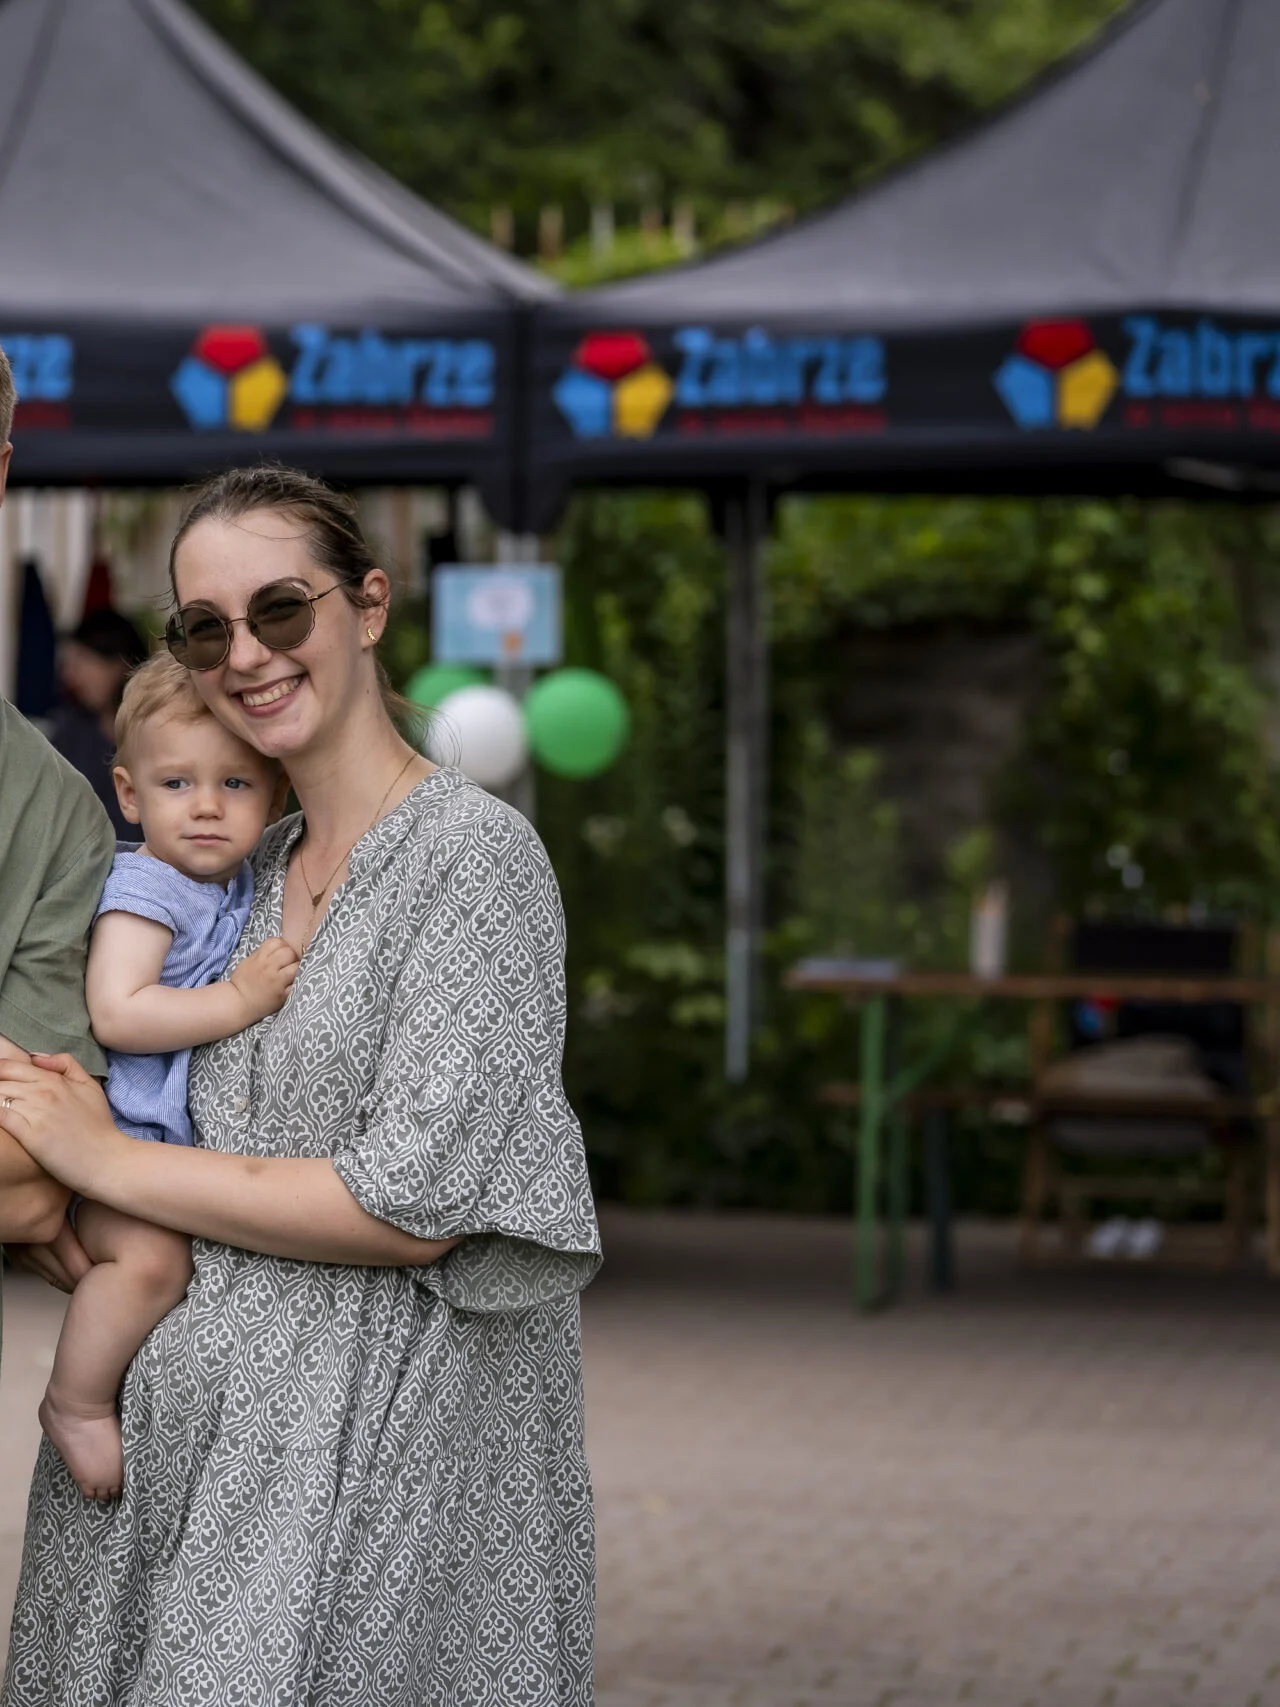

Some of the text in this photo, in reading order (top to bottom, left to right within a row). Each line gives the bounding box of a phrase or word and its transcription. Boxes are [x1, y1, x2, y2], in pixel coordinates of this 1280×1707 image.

[291, 323, 495, 406] Zabrze
[675, 326, 887, 406] Zabrze
[1123, 317, 1280, 398] Zabr
